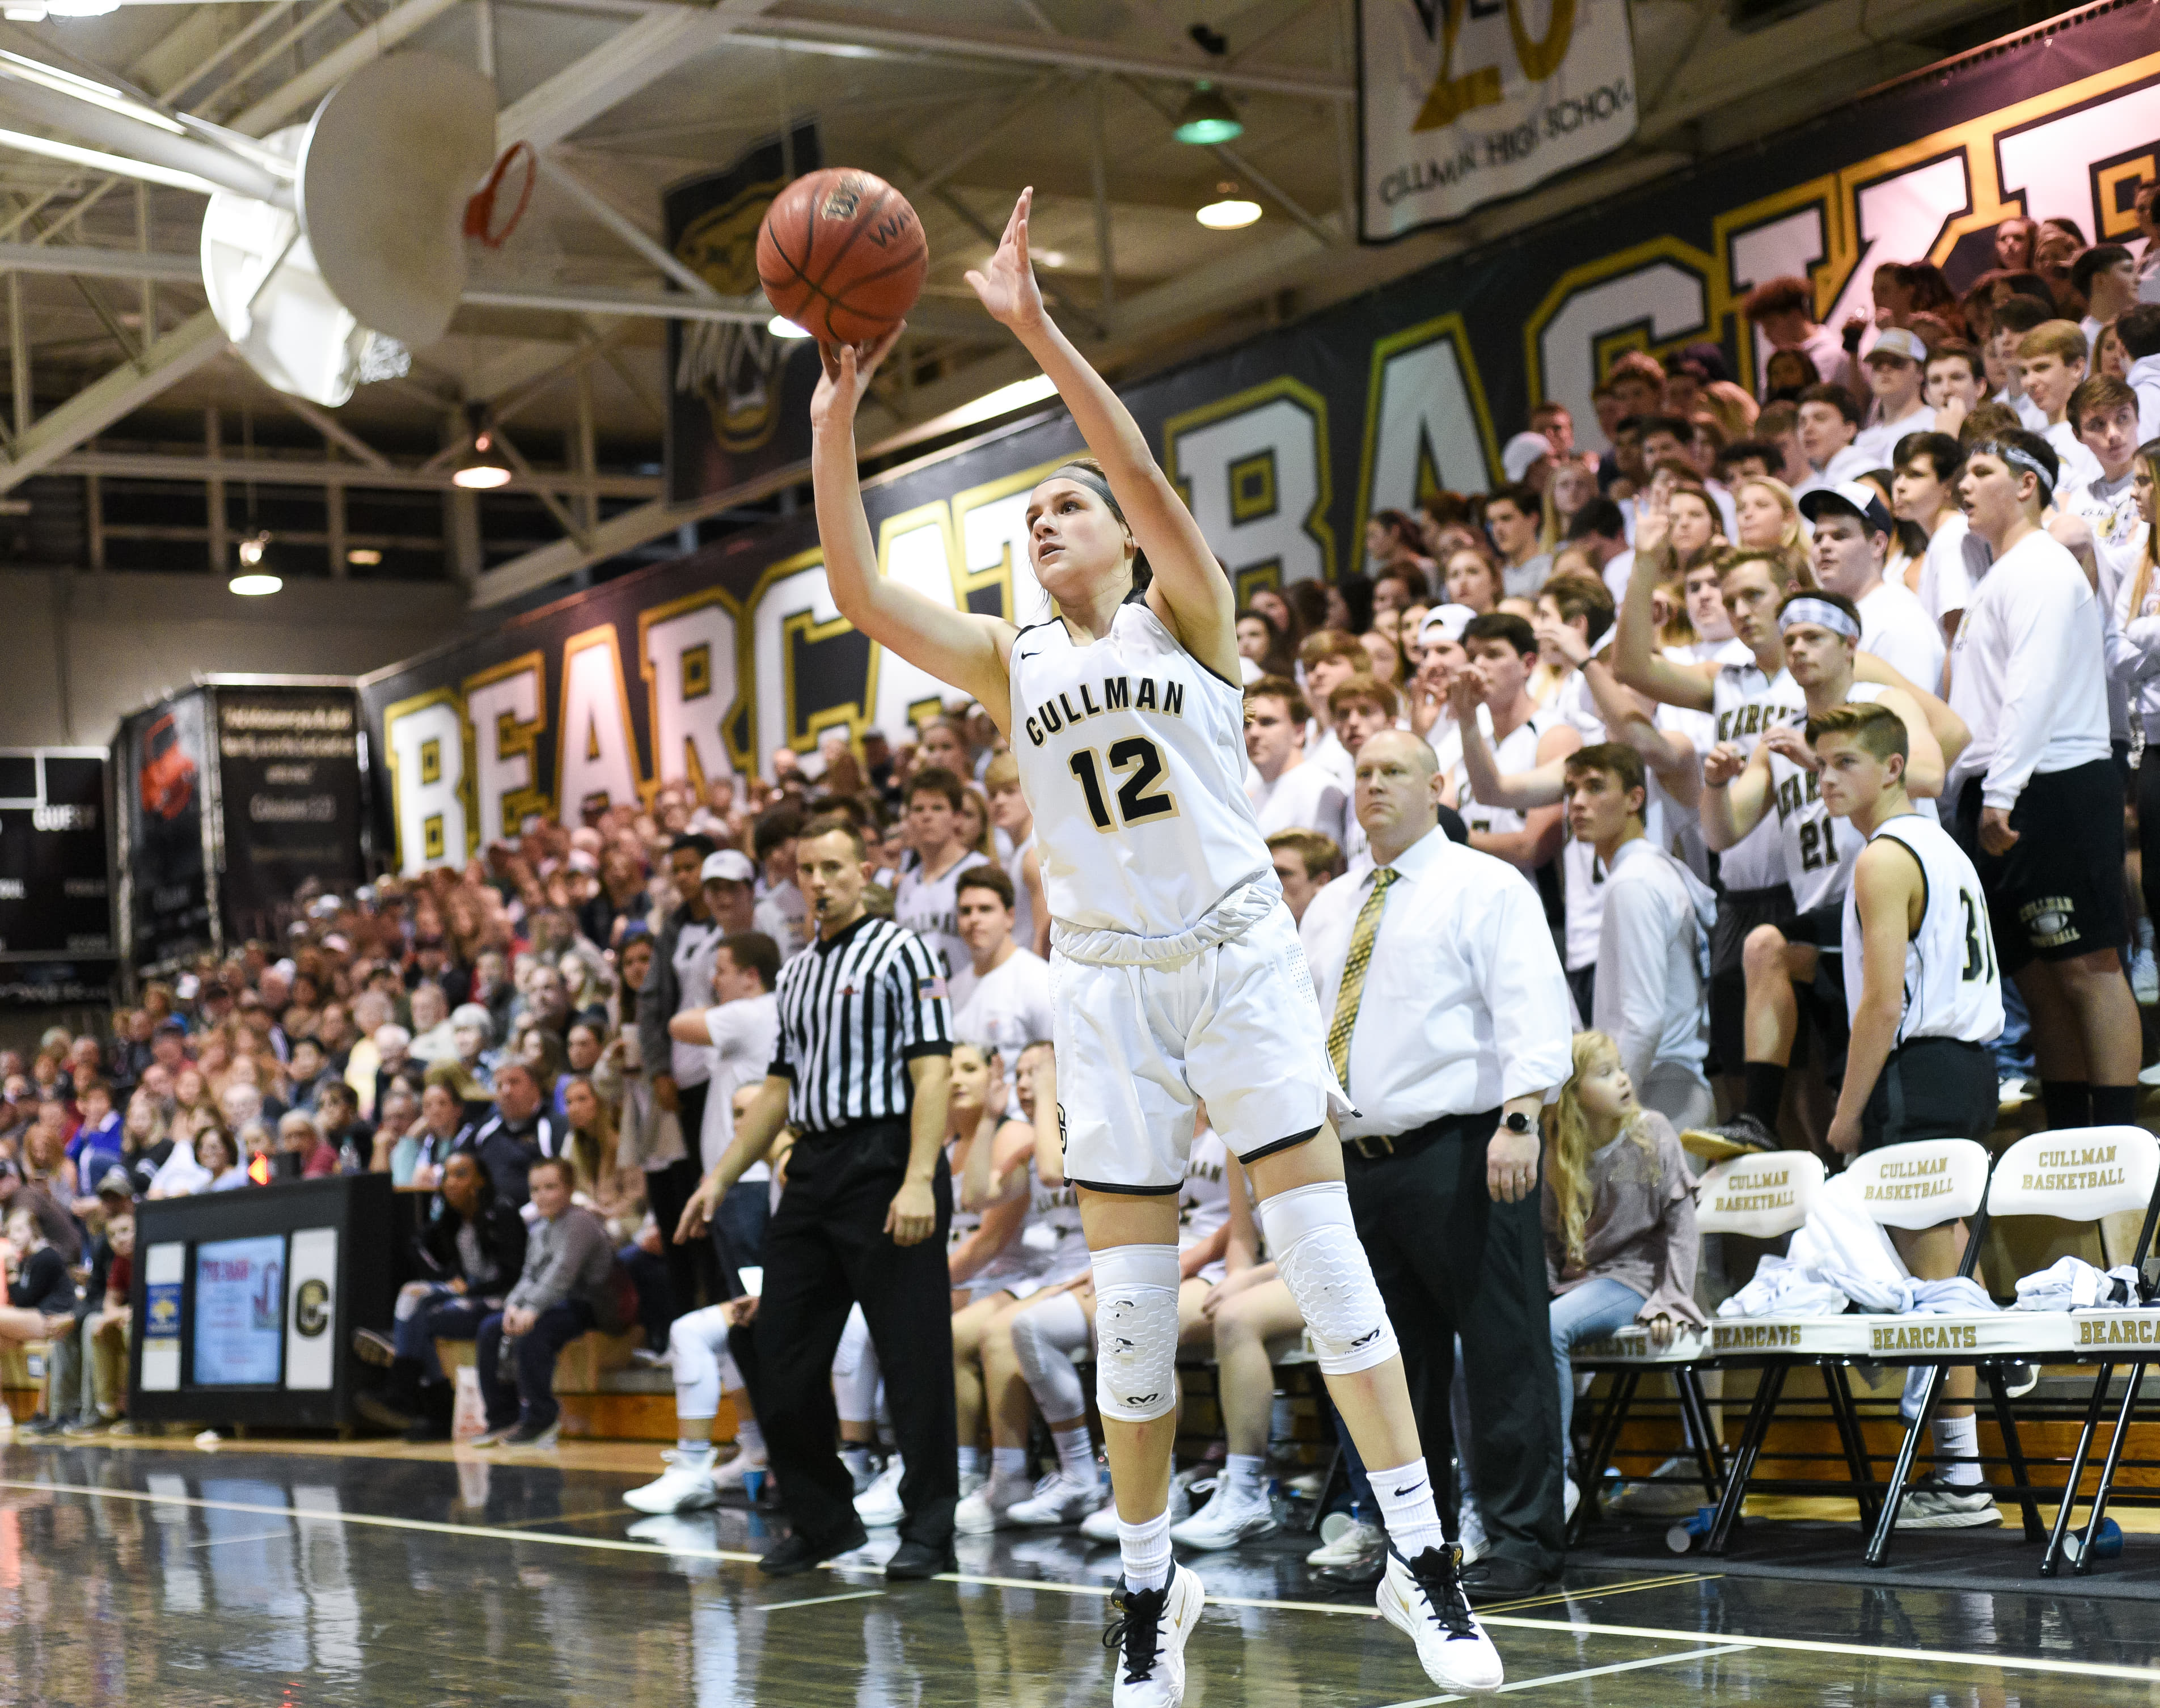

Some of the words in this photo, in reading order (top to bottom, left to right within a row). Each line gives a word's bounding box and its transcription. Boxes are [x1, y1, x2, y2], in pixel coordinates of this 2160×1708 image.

[1025, 675, 1185, 747] CULLMAN
[1067, 734, 1181, 834] 12
[1799, 815, 1840, 872] 21
[2039, 1145, 2117, 1167] CULLMAN
[1880, 1157, 1948, 1179] CULLMAN
[2022, 1168, 2125, 1190] BASKETBALL
[1728, 1170, 1789, 1190] CULLMAN
[1864, 1178, 1954, 1200] BASKETBALL
[1715, 1191, 1794, 1212] BASKETBALL
[1713, 1325, 1801, 1350] BEARCATS
[1873, 1326, 1977, 1350] BEARCATS
